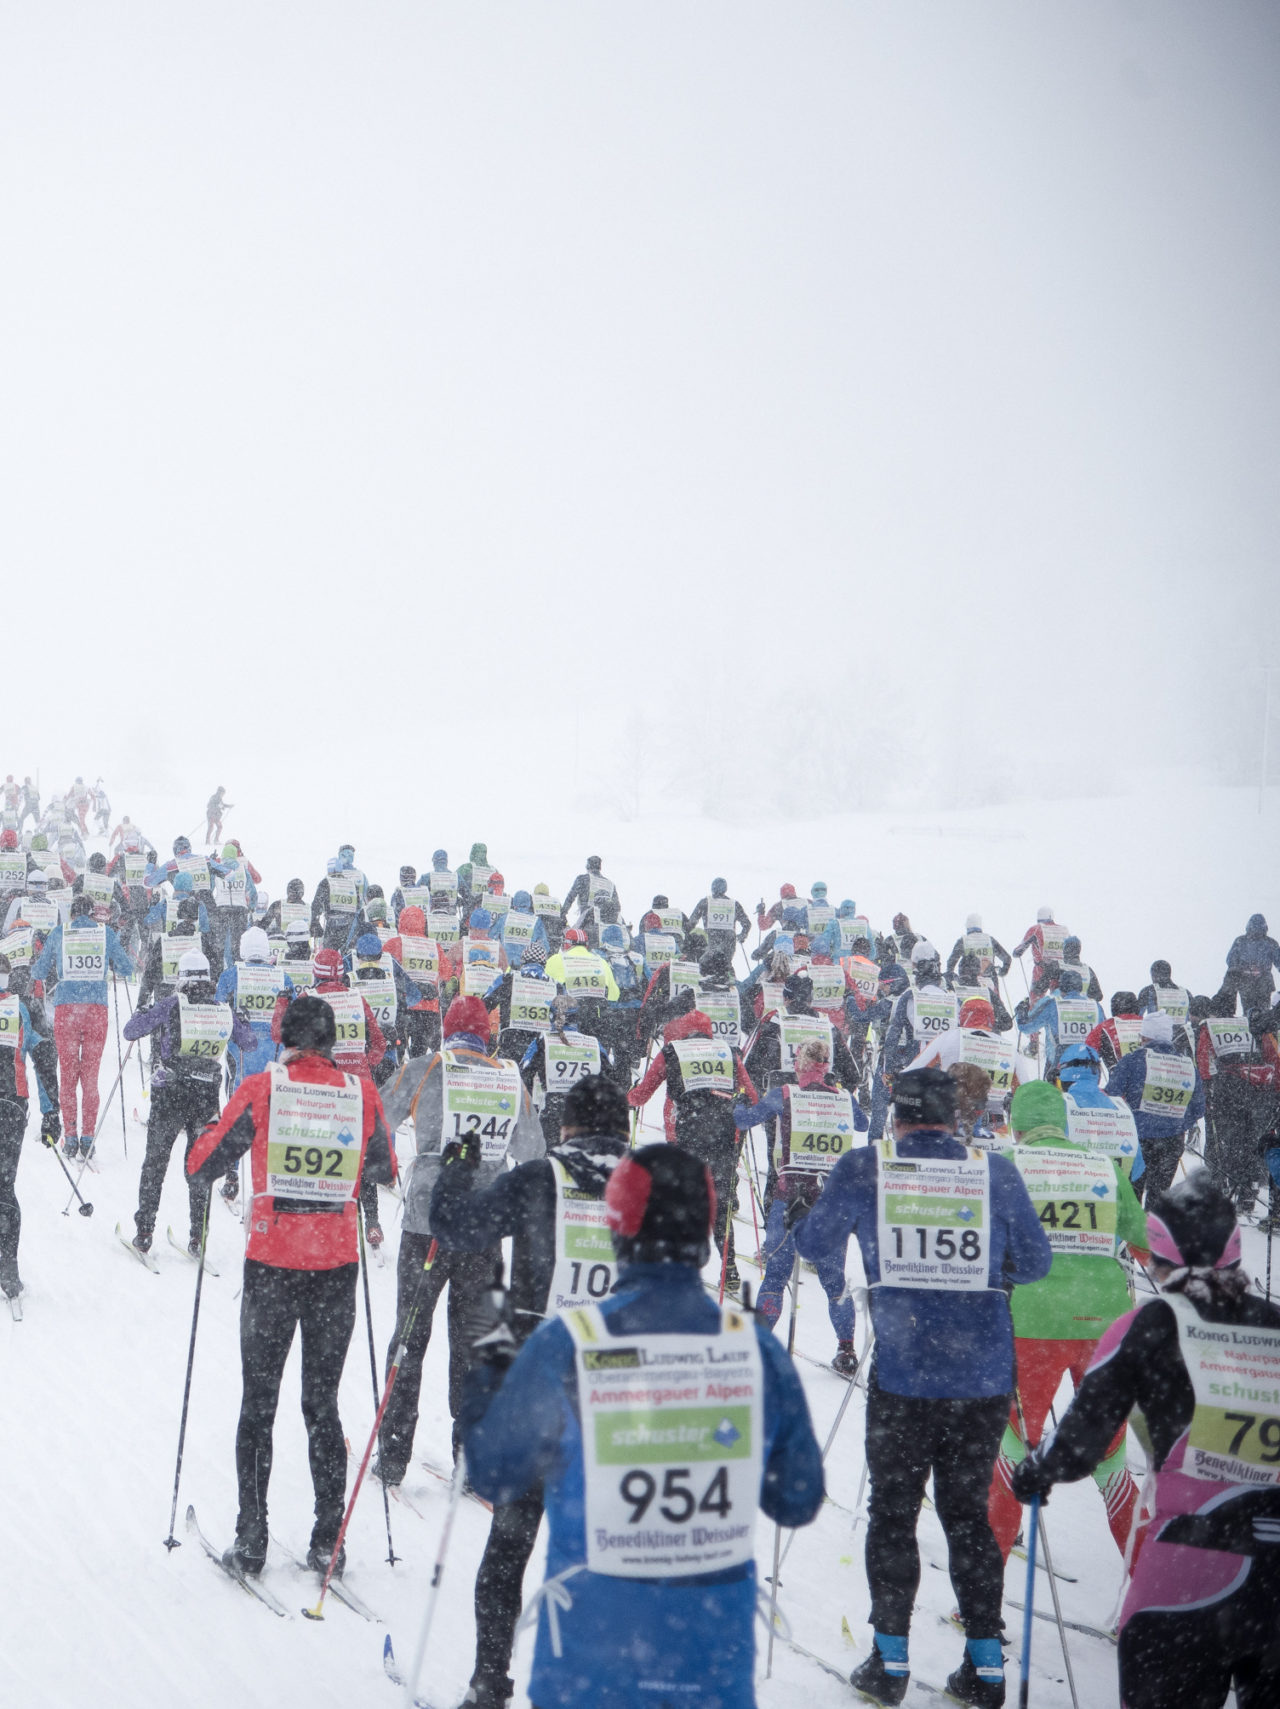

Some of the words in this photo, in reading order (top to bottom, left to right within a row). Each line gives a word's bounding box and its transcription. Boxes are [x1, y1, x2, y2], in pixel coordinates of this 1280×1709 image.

[0, 870, 25, 880] 1252
[194, 873, 206, 882] 09
[713, 913, 730, 922] 991
[435, 932, 454, 941] 707
[508, 928, 528, 937] 498
[68, 955, 102, 969] 1303
[409, 958, 433, 970] 578
[651, 952, 671, 961] 879
[573, 976, 600, 987] 418
[816, 986, 839, 998] 397
[246, 995, 276, 1010] 802
[372, 1006, 390, 1020] 76
[518, 1006, 548, 1020] 363
[712, 1022, 738, 1036] 002
[922, 1016, 950, 1031] 905
[1063, 1022, 1094, 1034] 1081
[338, 1024, 358, 1039] 13
[1216, 1032, 1250, 1046] 1061
[189, 1040, 220, 1057] 426
[556, 1060, 592, 1078] 975
[690, 1061, 725, 1075] 304
[988, 1070, 1008, 1088] 14
[1152, 1086, 1185, 1104] 394
[277, 1124, 336, 1140] schuster
[454, 1112, 512, 1140] 1244
[802, 1134, 843, 1154] 460
[284, 1146, 344, 1178] 592
[884, 1181, 952, 1194] Ammergauer
[954, 1185, 984, 1197] Alpen
[1028, 1180, 1091, 1193] schuster
[896, 1203, 956, 1217] schuster
[1039, 1201, 1098, 1230] 421
[564, 1212, 610, 1226] Ammerg
[576, 1236, 614, 1250] schus
[892, 1227, 982, 1262] 1158
[1048, 1232, 1077, 1243] diktiner
[884, 1260, 938, 1275] Benediktiner
[1186, 1325, 1230, 1344] KÖNIG
[641, 1348, 704, 1366] LUDWIG
[706, 1346, 750, 1364] LAUF
[1224, 1350, 1280, 1367] Naturpa
[1200, 1360, 1280, 1380] Ammergaue
[589, 1386, 700, 1405] Ammergauer
[706, 1384, 753, 1401] Alpen
[1208, 1382, 1280, 1405] schust
[611, 1423, 712, 1446] schuster
[1224, 1412, 1280, 1462] 79
[1194, 1450, 1273, 1483] Benediktiner
[620, 1466, 732, 1525] 954
[595, 1528, 687, 1552] Benediktiner
[692, 1525, 749, 1546] Weissbier
